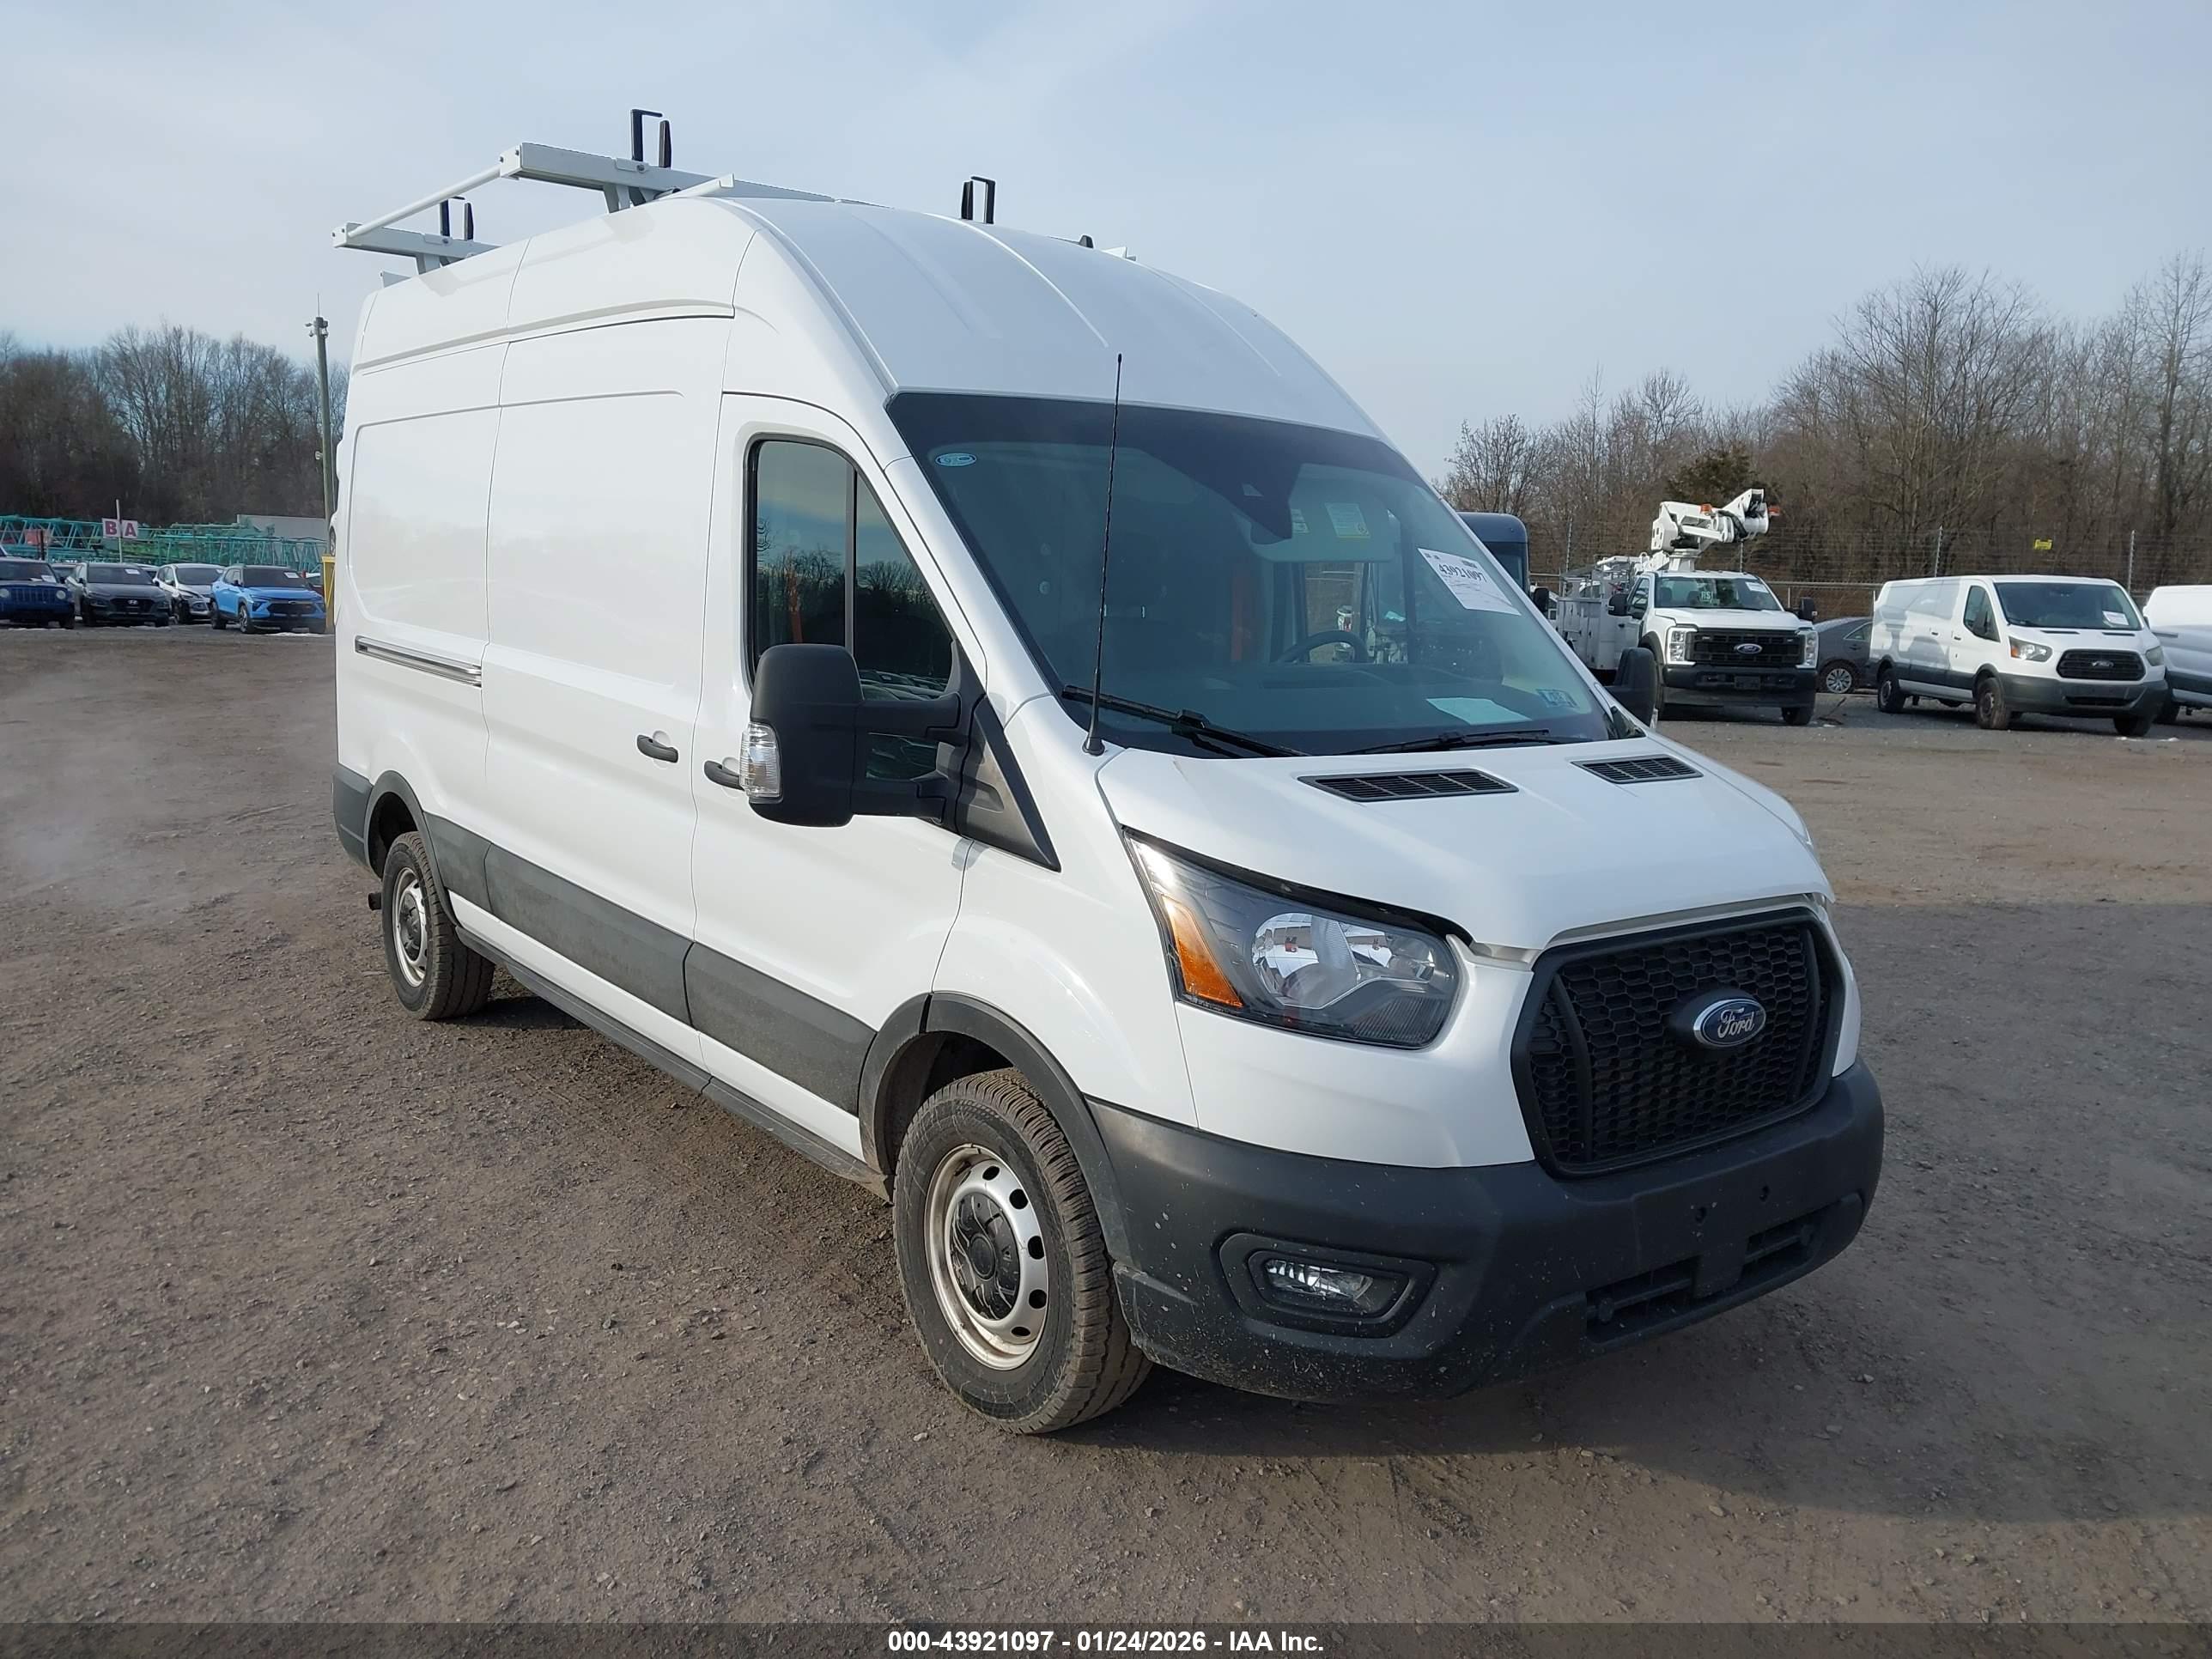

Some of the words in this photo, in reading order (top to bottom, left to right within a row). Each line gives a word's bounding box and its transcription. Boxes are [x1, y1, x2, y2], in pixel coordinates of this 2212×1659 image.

[106, 520, 118, 535] B
[125, 522, 137, 537] A
[1438, 563, 1487, 583] 43921097
[1717, 1007, 1755, 1038] Ford
